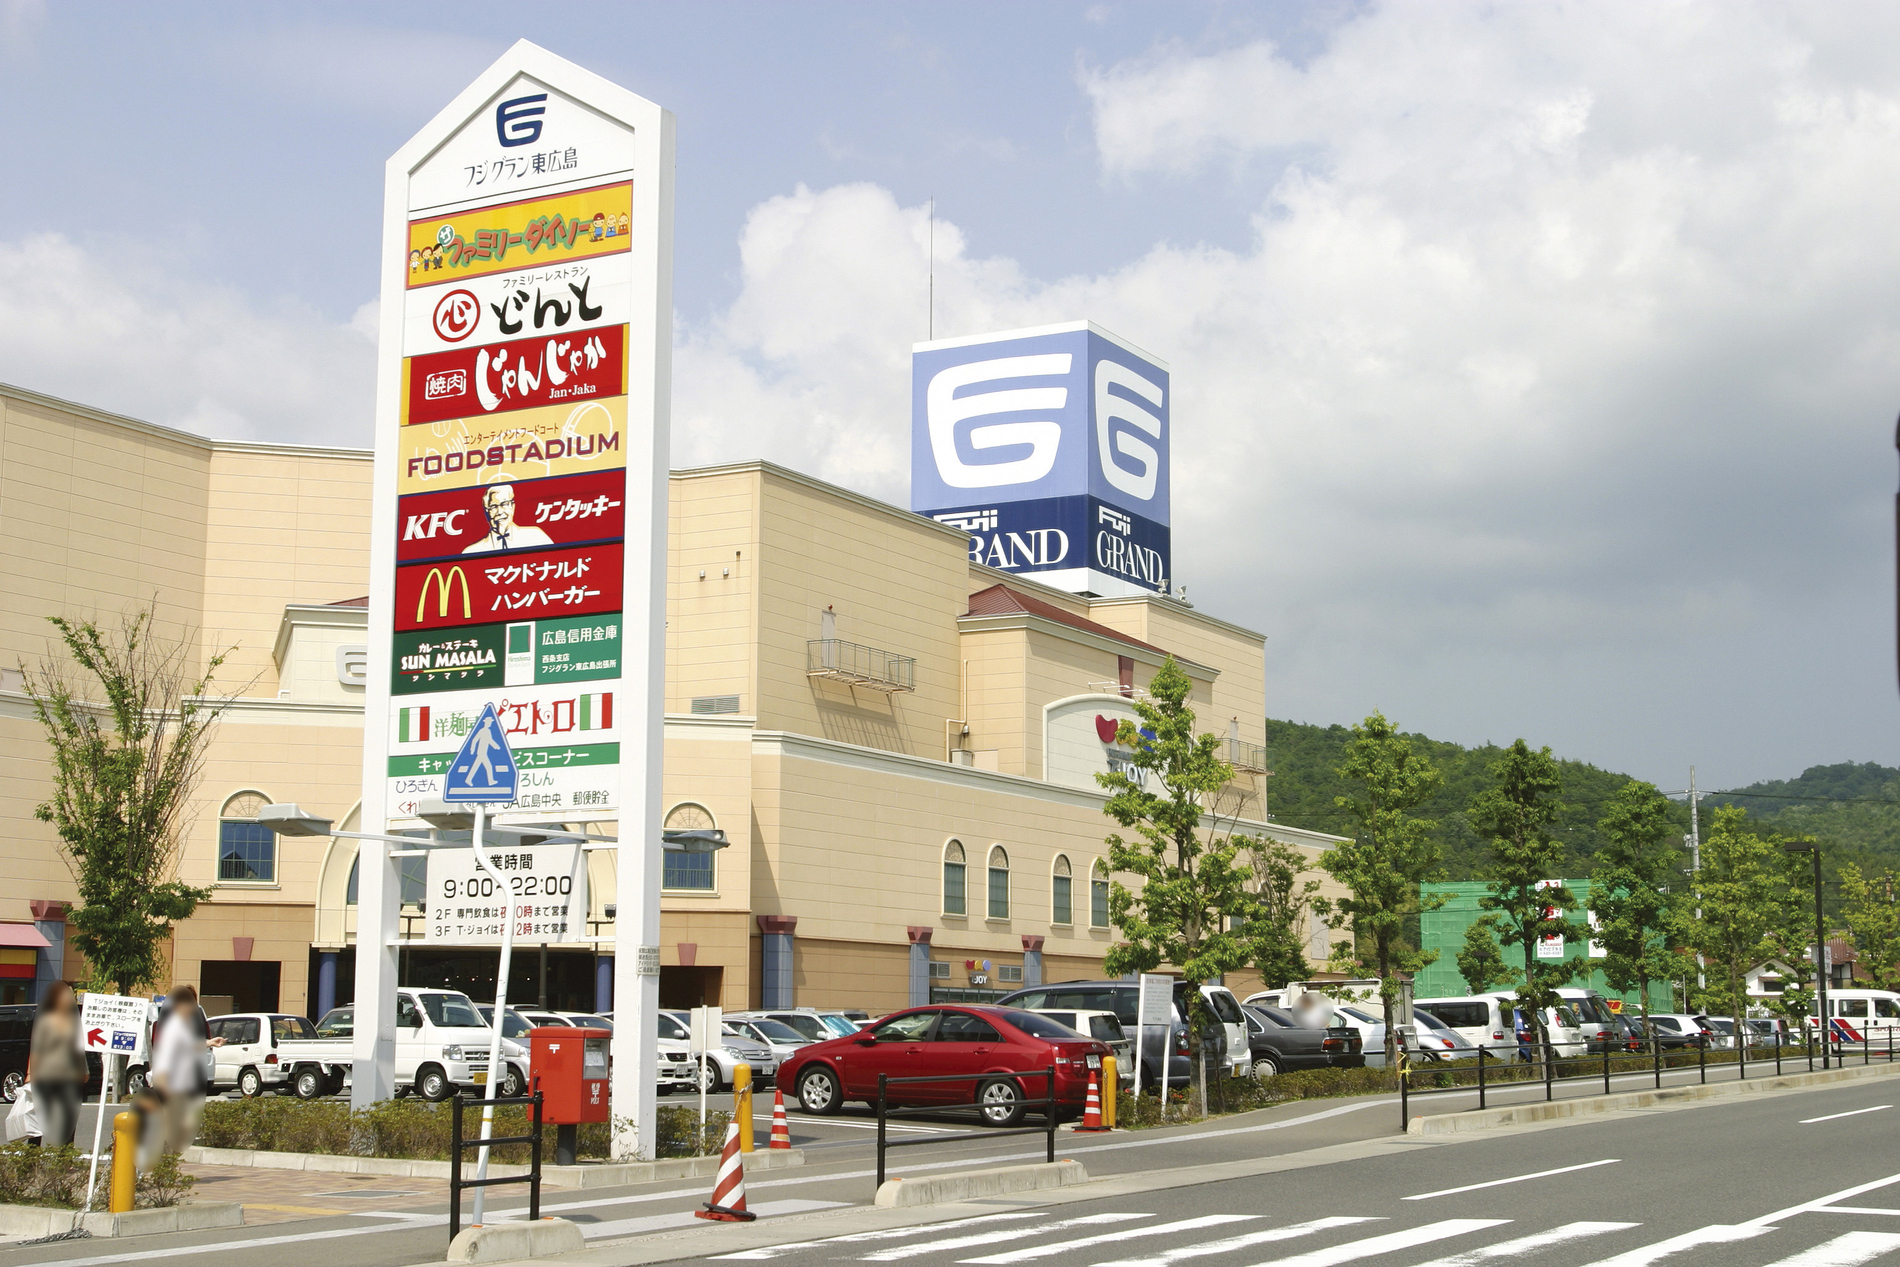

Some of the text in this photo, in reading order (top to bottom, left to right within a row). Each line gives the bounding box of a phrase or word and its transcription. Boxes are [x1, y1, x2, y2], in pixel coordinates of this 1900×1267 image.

[464, 147, 578, 188] フジグラン東広島
[446, 215, 592, 265] ファミリーダイソー
[502, 266, 589, 289] ファミリーレストラン
[490, 275, 603, 335] どんと
[429, 335, 606, 411] 焼肉 じゃんじゃか
[408, 431, 620, 477] FOODSTADIUM
[535, 495, 621, 523] ケンタッキー
[403, 509, 466, 541] KFC
[969, 528, 1070, 569] RAND
[1096, 530, 1164, 585] GRAND
[484, 557, 592, 585] マクドナルド
[491, 585, 600, 612] ハンバーガー
[541, 624, 618, 646] 広島信用金庫
[401, 649, 497, 671] SUN MASALA
[541, 659, 617, 674] フジグラン東広島出張所
[395, 779, 439, 794] ひろぎん
[572, 790, 610, 806] 郵便貯金
[435, 908, 452, 920] 2F
[435, 925, 452, 937] 3F
